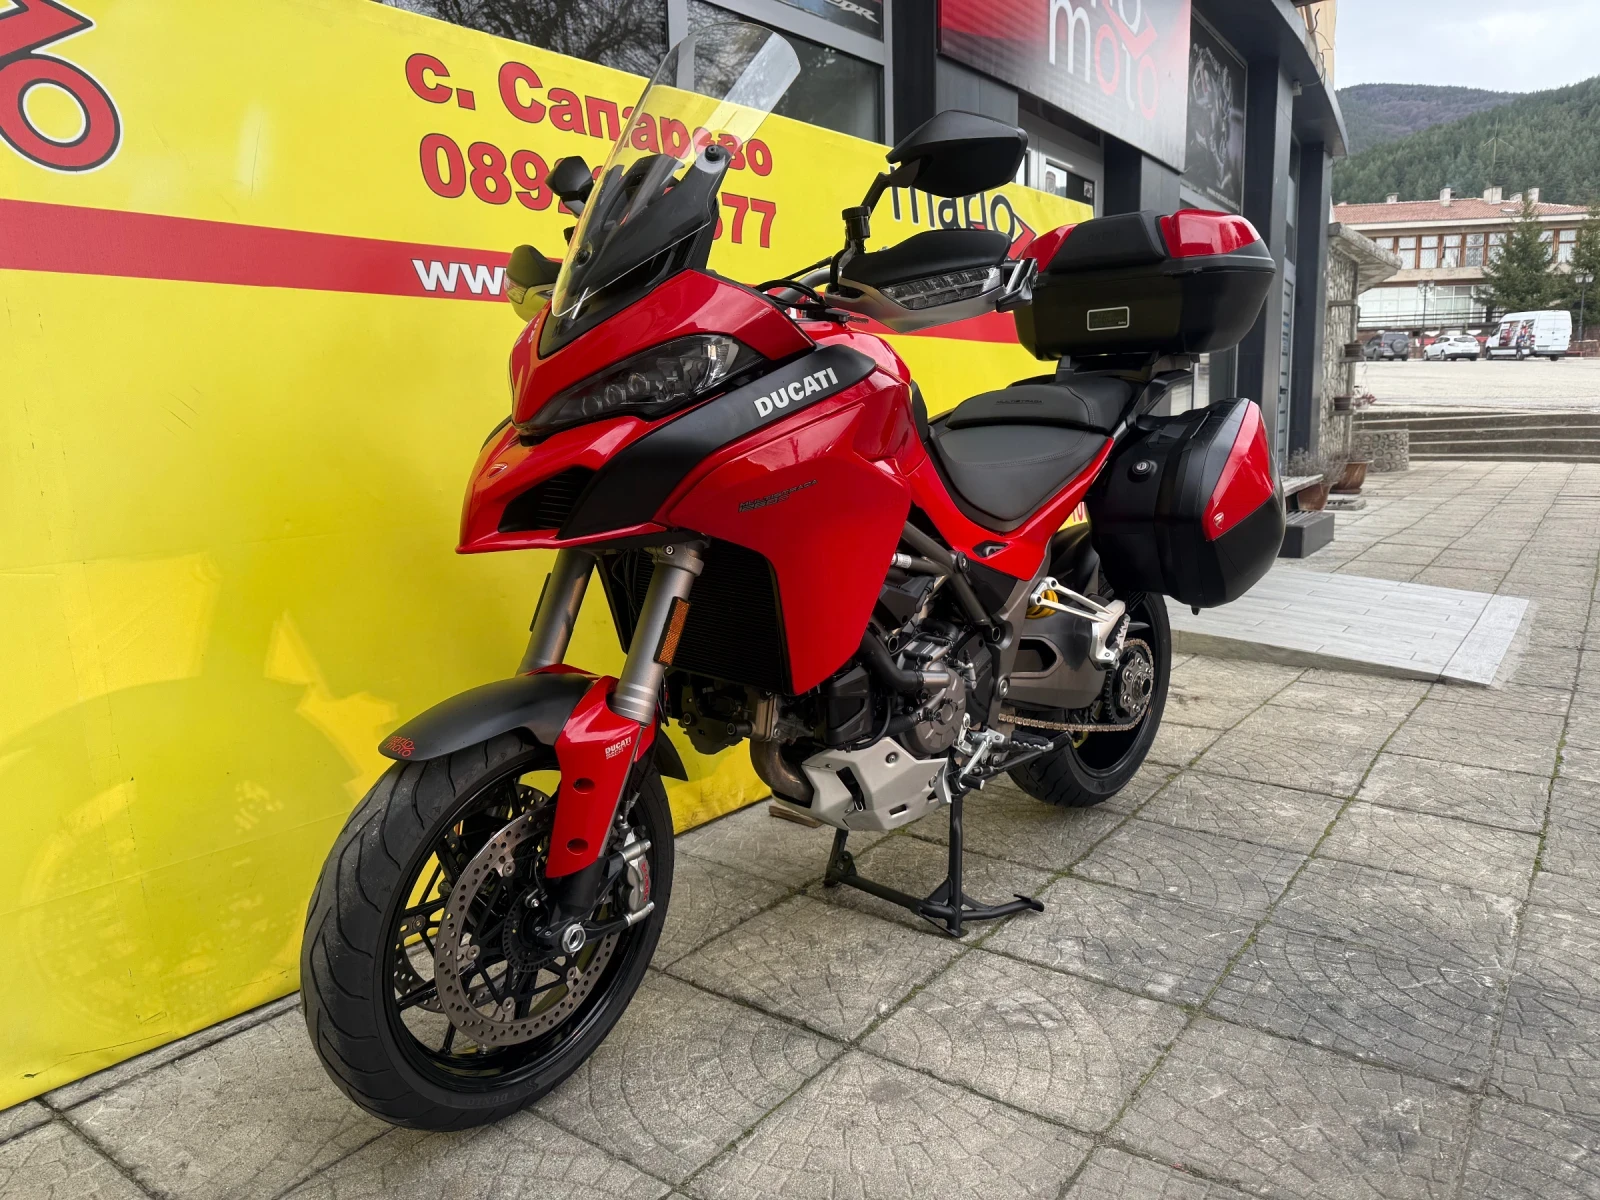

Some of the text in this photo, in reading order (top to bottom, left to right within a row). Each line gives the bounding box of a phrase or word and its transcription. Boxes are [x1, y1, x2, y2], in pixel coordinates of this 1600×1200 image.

[1048, 0, 1159, 121] moto
[753, 367, 839, 418] DUCATI
[604, 736, 632, 755] DUCATI
